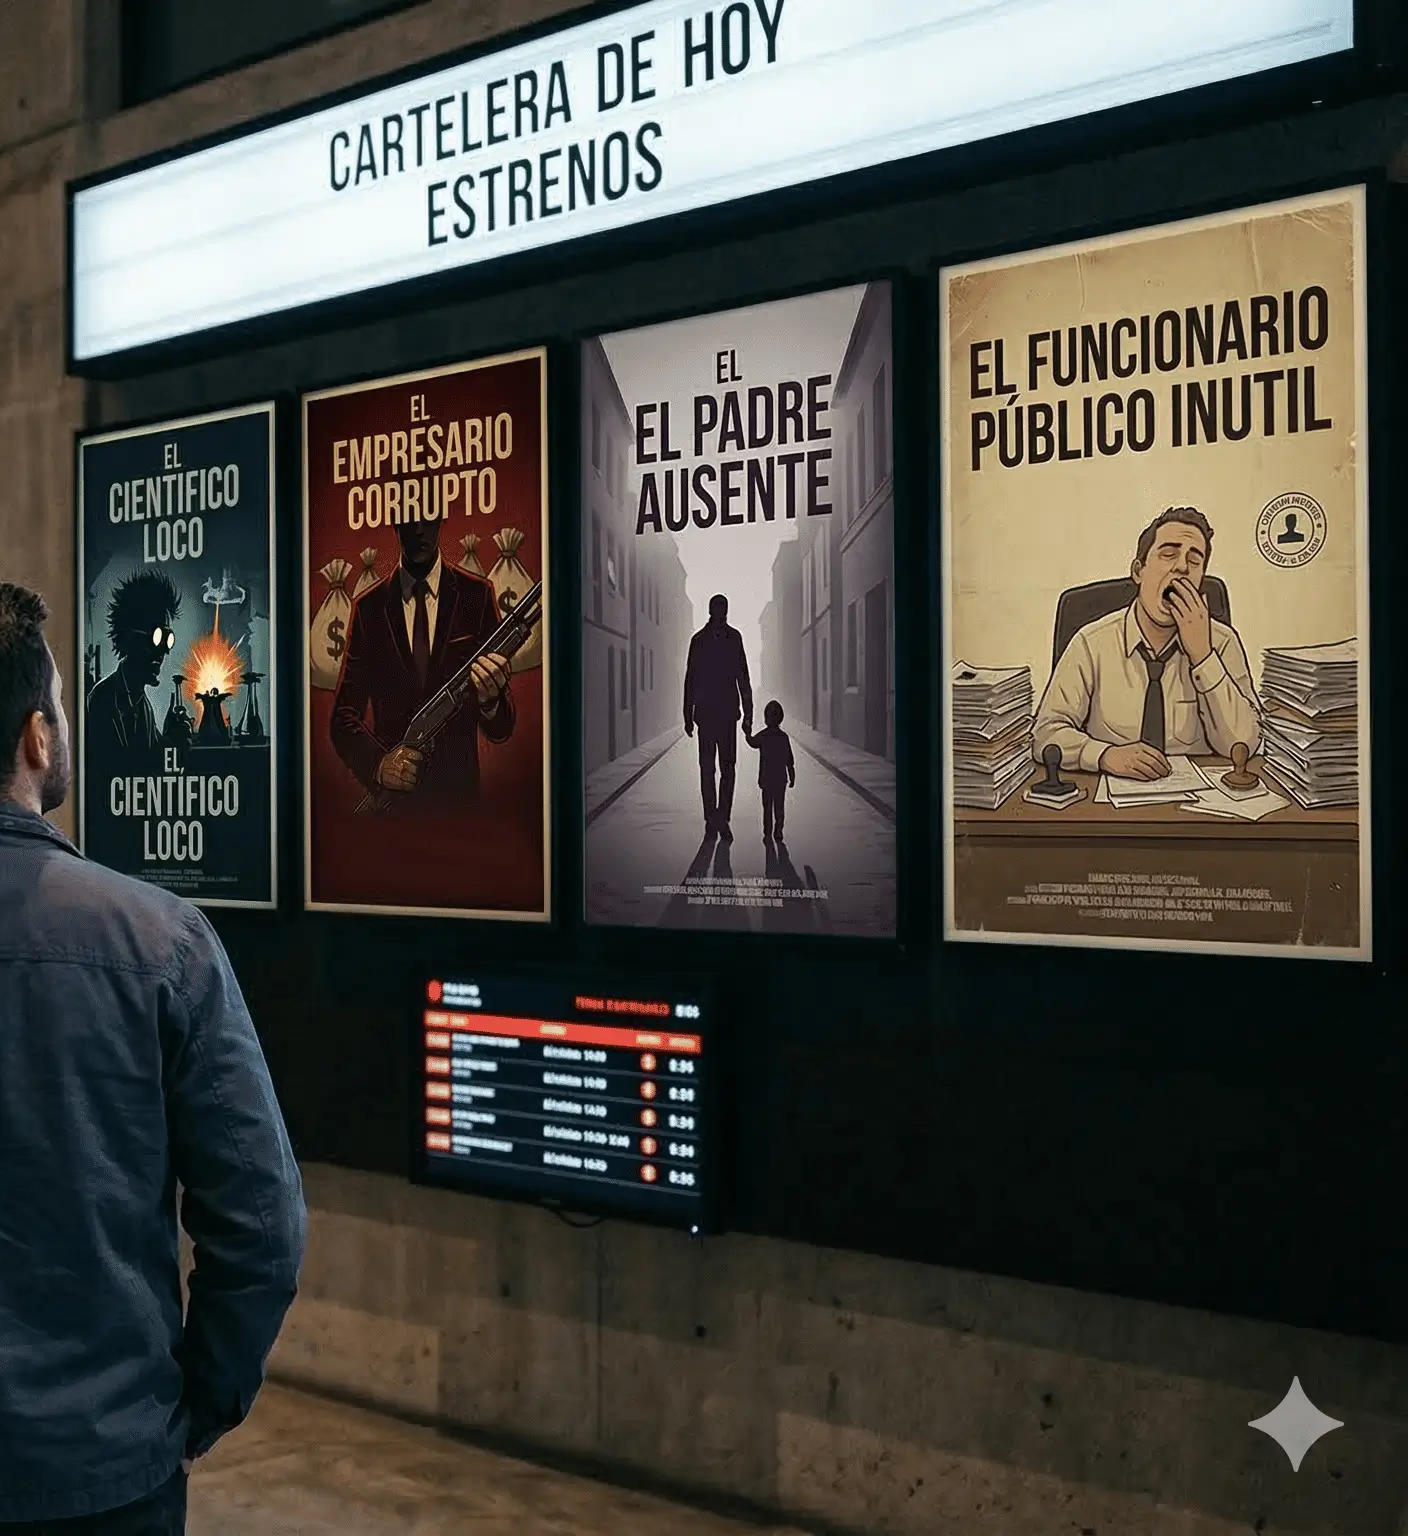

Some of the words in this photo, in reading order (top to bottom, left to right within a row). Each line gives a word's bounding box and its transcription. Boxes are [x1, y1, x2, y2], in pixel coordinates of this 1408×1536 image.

[328, 59, 573, 192] CARTELERA
[595, 29, 659, 113] DE
[682, 0, 786, 88] HOY
[426, 121, 664, 247] ESTRENOS
[716, 349, 743, 384] EL
[970, 338, 1017, 399] EL
[1028, 285, 1329, 391] FUNCIONARIO
[410, 394, 431, 422] EL
[635, 401, 682, 465] EL
[693, 373, 833, 457] PADRE
[970, 393, 1156, 472] PÚBLICO
[1171, 365, 1333, 448] INUTIL
[164, 442, 182, 470] EL
[333, 412, 513, 484] EMPRESARIO
[109, 463, 240, 524] CIENTIFICO
[347, 466, 497, 531] CORRUPTO
[635, 448, 833, 535] AUSENTE
[143, 516, 204, 564] LOCO
[144, 820, 204, 862] LOCO
